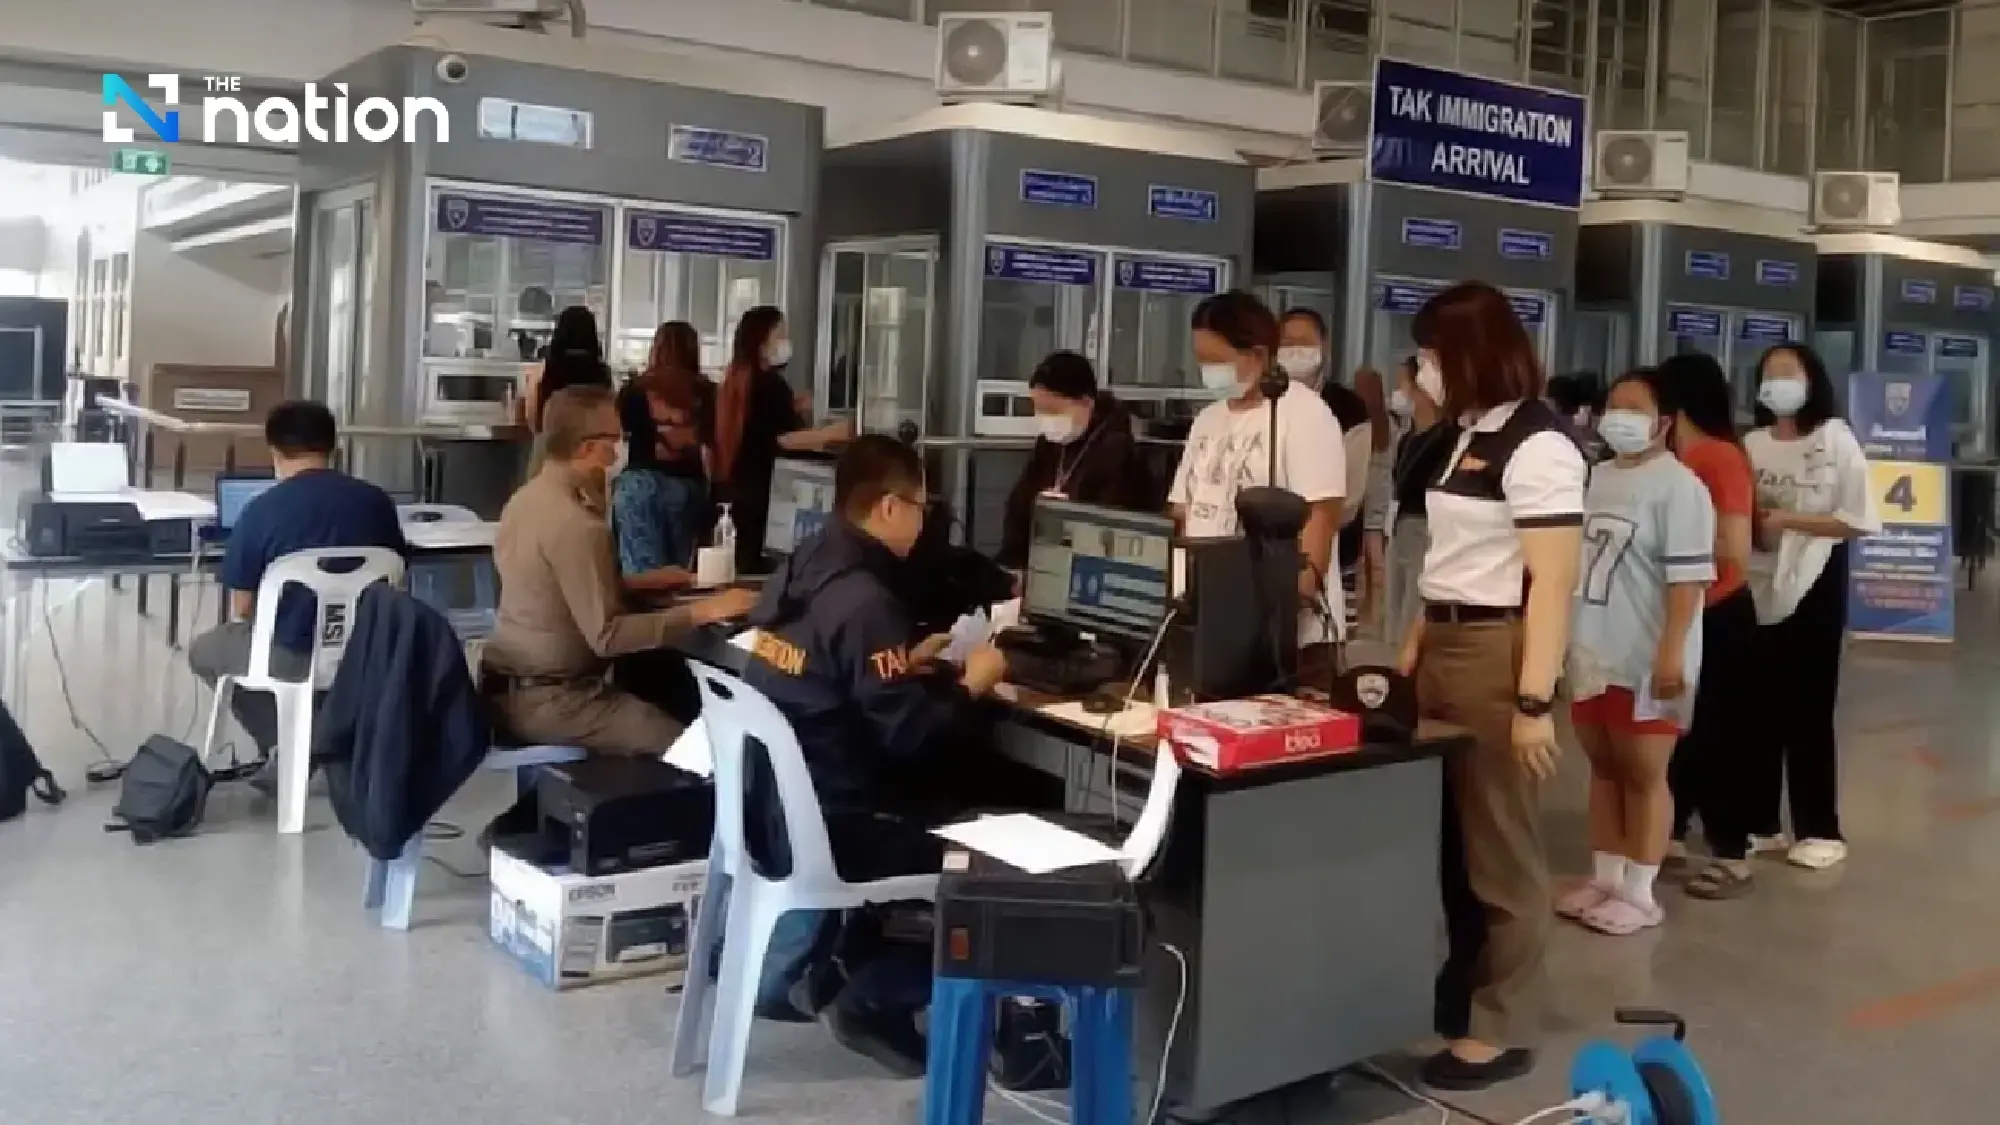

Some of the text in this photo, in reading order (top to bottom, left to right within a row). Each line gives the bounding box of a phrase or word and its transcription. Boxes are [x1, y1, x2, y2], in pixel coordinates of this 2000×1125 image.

[1388, 85, 1573, 148] TAK IMMIGRATION
[1431, 141, 1531, 185] ARRIVAL
[1884, 474, 1919, 512] 4
[1585, 512, 1638, 607] 7
